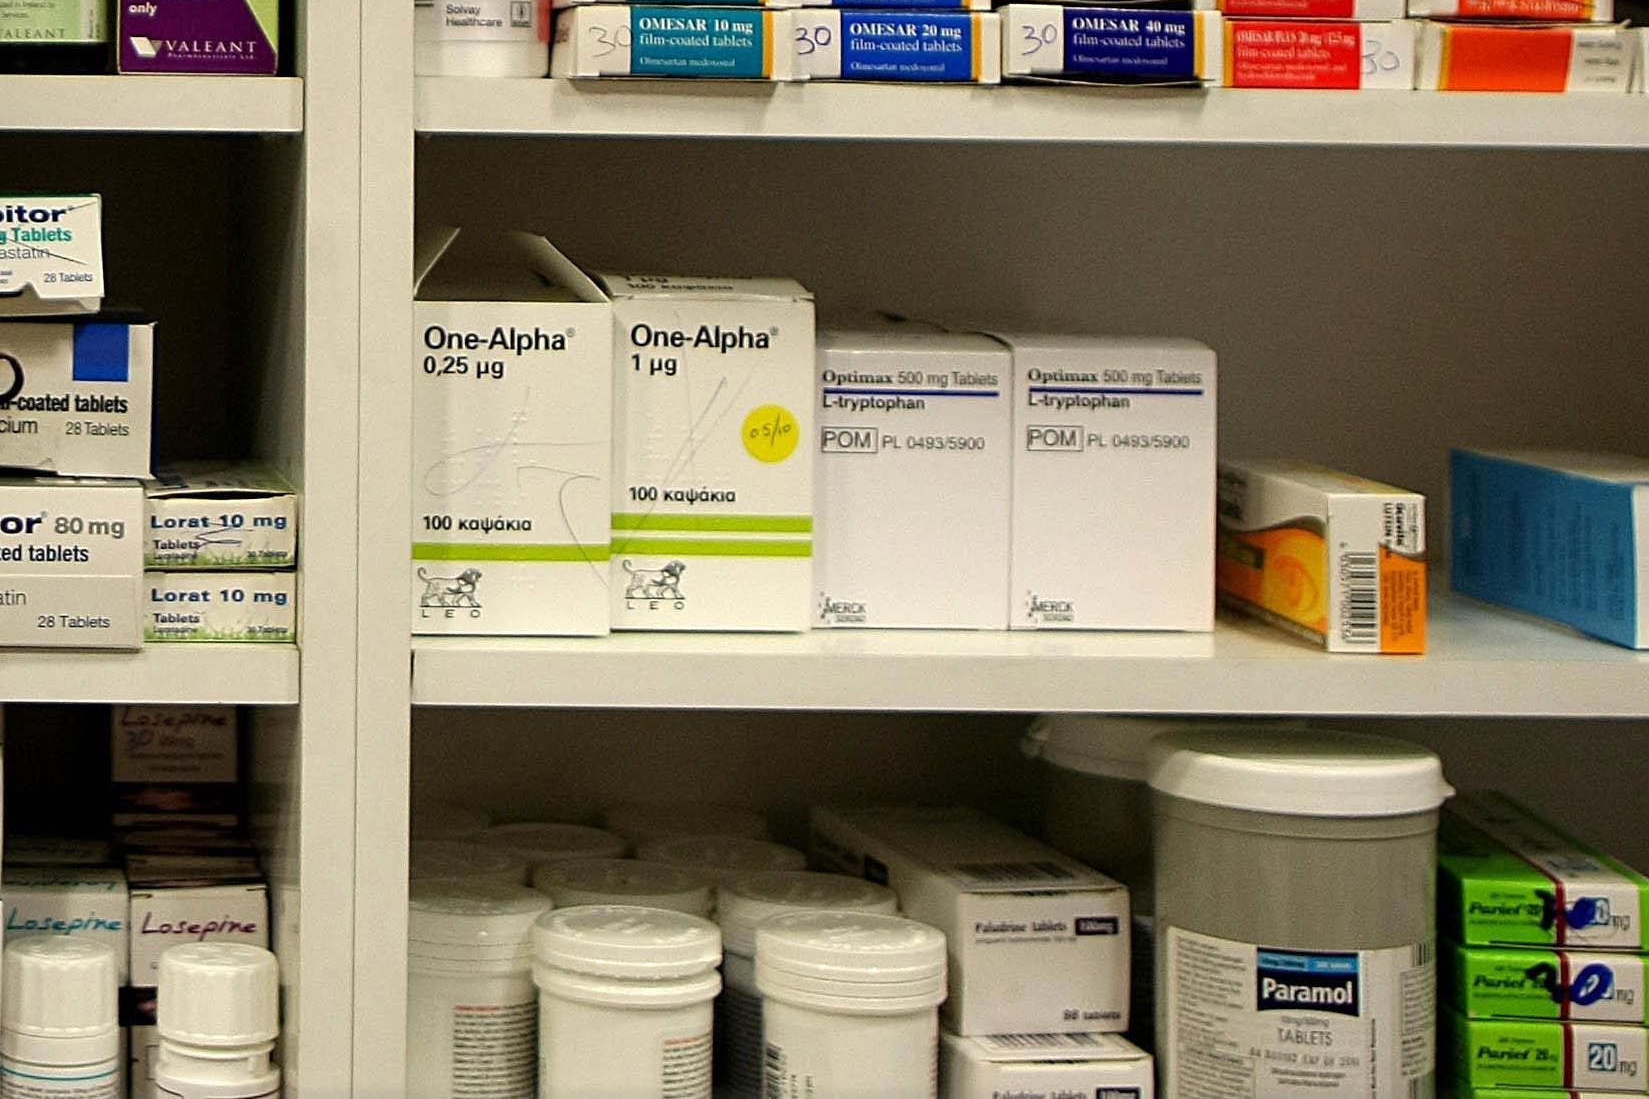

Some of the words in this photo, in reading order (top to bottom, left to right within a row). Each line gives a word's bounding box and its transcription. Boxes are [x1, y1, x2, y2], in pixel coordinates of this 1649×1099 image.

[128, 2, 157, 16] only
[446, 3, 481, 17] Solvay
[446, 17, 502, 28] Healthcare
[165, 41, 257, 53] VALEANT
[795, 25, 831, 54] 30
[423, 357, 469, 376] 0,25
[823, 370, 892, 385] Optimax
[898, 372, 923, 385] 500
[927, 374, 948, 388] mg
[953, 373, 998, 386] Tablets
[823, 396, 925, 411] L-tryptophan
[66, 421, 81, 435] 28
[84, 422, 129, 437] Tablets
[824, 432, 872, 448] POM
[883, 436, 901, 449] PL
[907, 436, 985, 450] 0493/5900
[54, 518, 83, 535] 80
[88, 518, 125, 540] mg
[151, 516, 209, 529] Lorat
[220, 515, 244, 529] 10
[253, 517, 287, 530] mg
[423, 516, 452, 531] 100
[458, 516, 532, 534] καψάκια
[29, 545, 89, 563] tablets
[421, 609, 481, 618] LEO
[37, 615, 55, 628] 28
[58, 615, 111, 630] Tablets
[142, 912, 256, 941] Losepine
[1263, 977, 1352, 1004] Paramol
[1278, 1028, 1332, 1045] TABLETS
